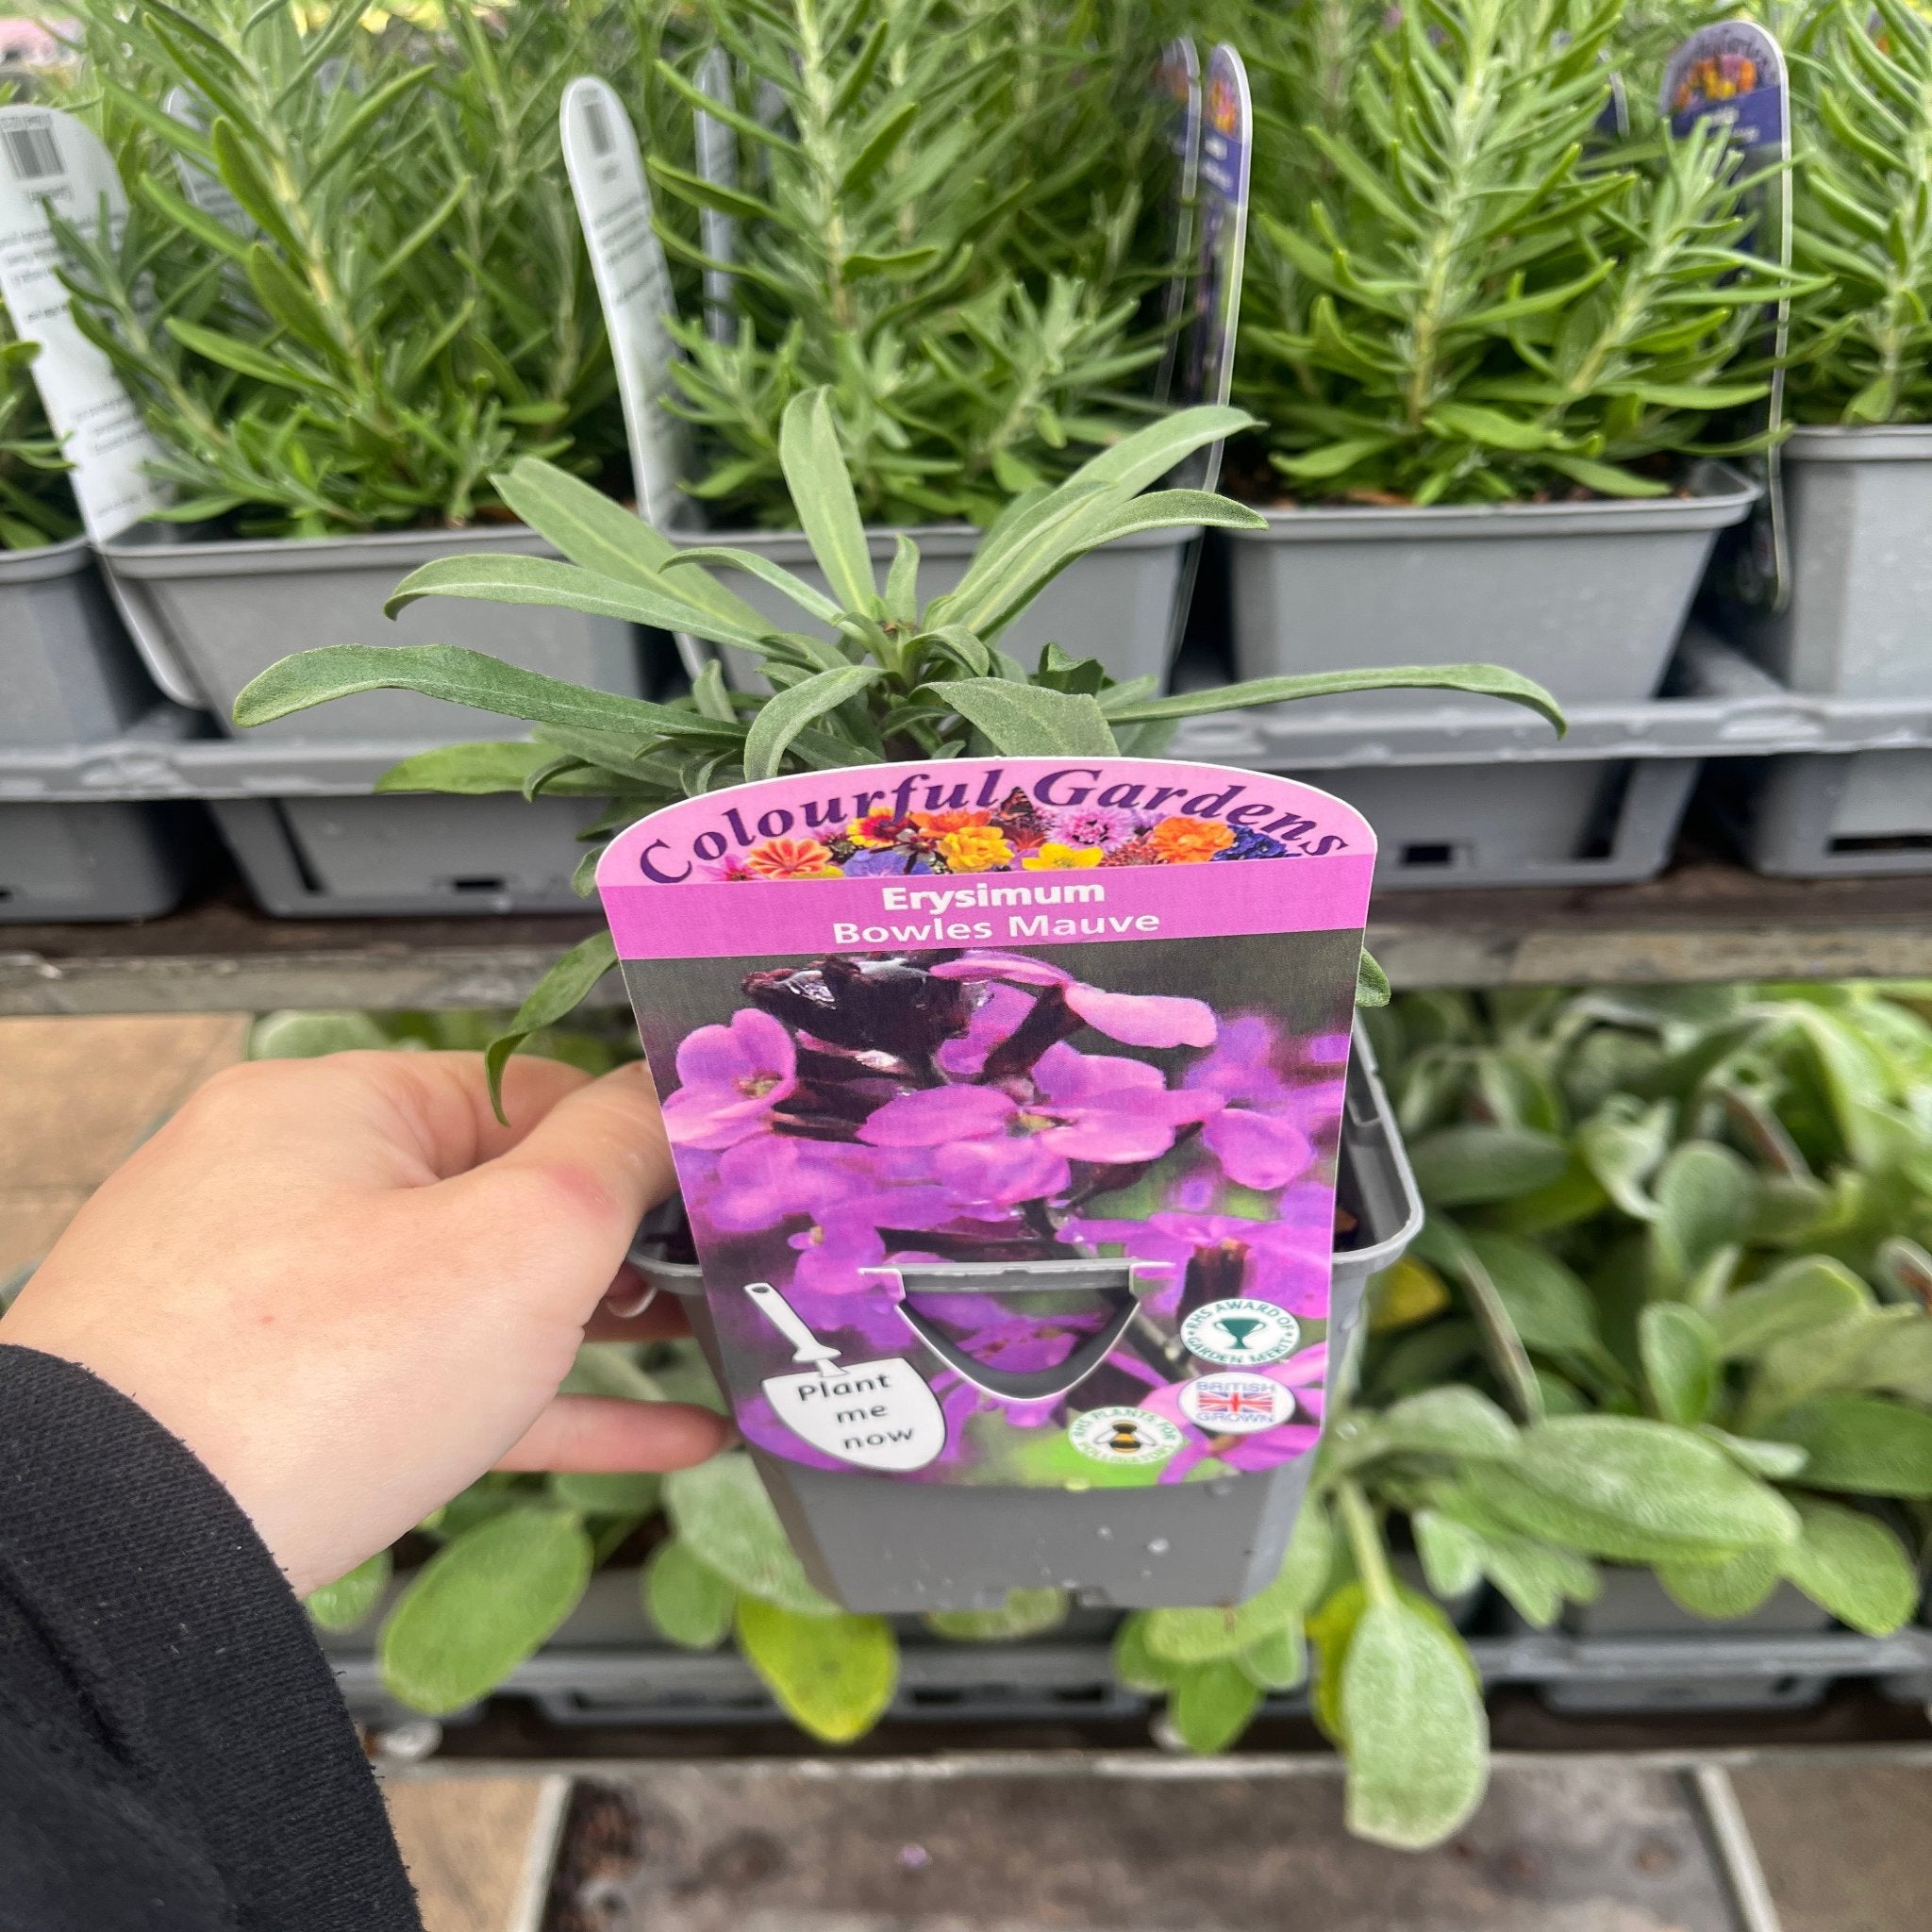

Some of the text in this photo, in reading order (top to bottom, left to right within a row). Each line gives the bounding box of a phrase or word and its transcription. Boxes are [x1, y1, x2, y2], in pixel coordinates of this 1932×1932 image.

[640, 768, 1349, 884] Colourful Gardens
[882, 882, 1106, 915] Erysimum
[832, 914, 1160, 944] Bowles Mauve
[1186, 1301, 1294, 1332] RHS AWARD OF
[1187, 1337, 1292, 1363] GARDEN MERIT
[797, 1373, 891, 1402] Plant
[1195, 1381, 1275, 1392] BRITISH
[836, 1405, 888, 1424] me
[1195, 1412, 1274, 1423] GROWN
[843, 1427, 914, 1451] now
